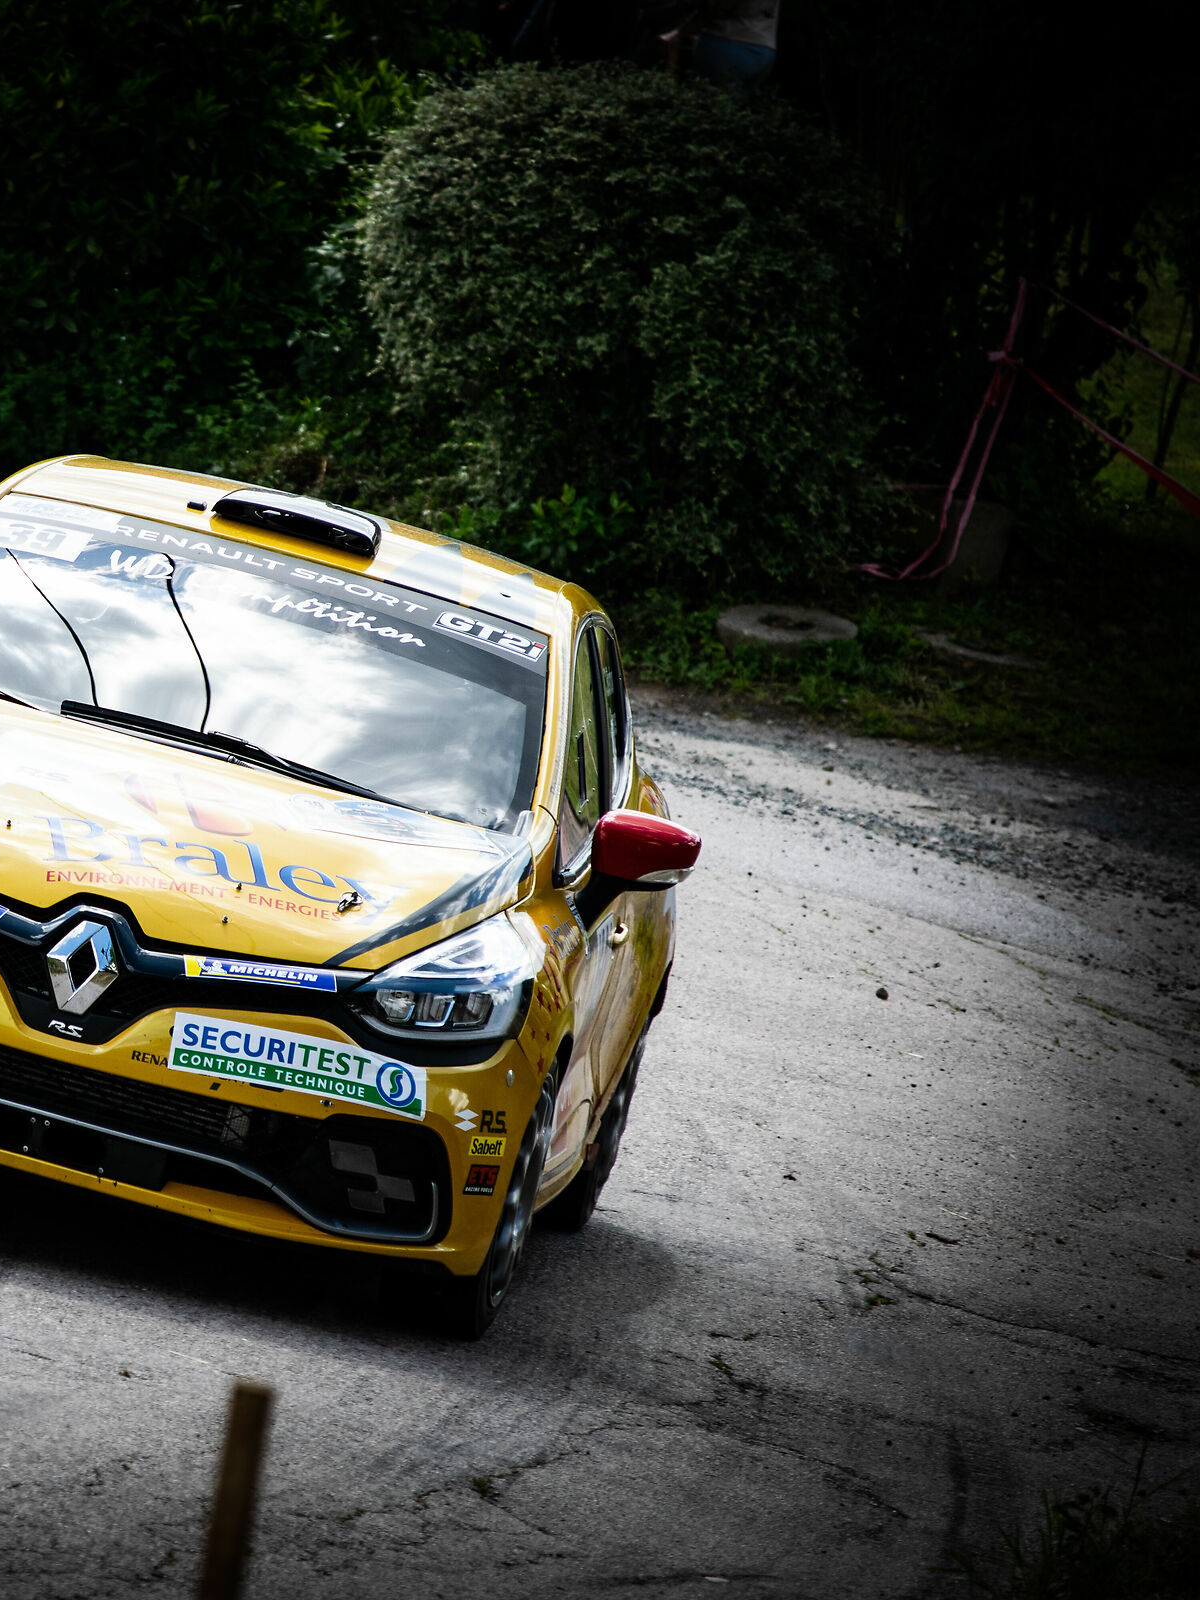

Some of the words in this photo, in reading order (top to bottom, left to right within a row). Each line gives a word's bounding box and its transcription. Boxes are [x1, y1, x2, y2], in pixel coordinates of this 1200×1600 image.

[113, 524, 286, 570] RENAULT
[290, 567, 428, 613] SPORT
[436, 611, 546, 660] GT2i
[45, 870, 228, 899] ENVIRONNEMENT
[248, 892, 341, 922] ENERGIES
[227, 965, 319, 982] MICHELIN
[131, 1050, 169, 1068] RENA
[181, 1022, 372, 1080] SECURITEST
[179, 1052, 266, 1078] CONTROLE
[275, 1069, 366, 1098] TECHNIQUE
[471, 1138, 503, 1156] Sabelt
[468, 1166, 498, 1184] ETS
